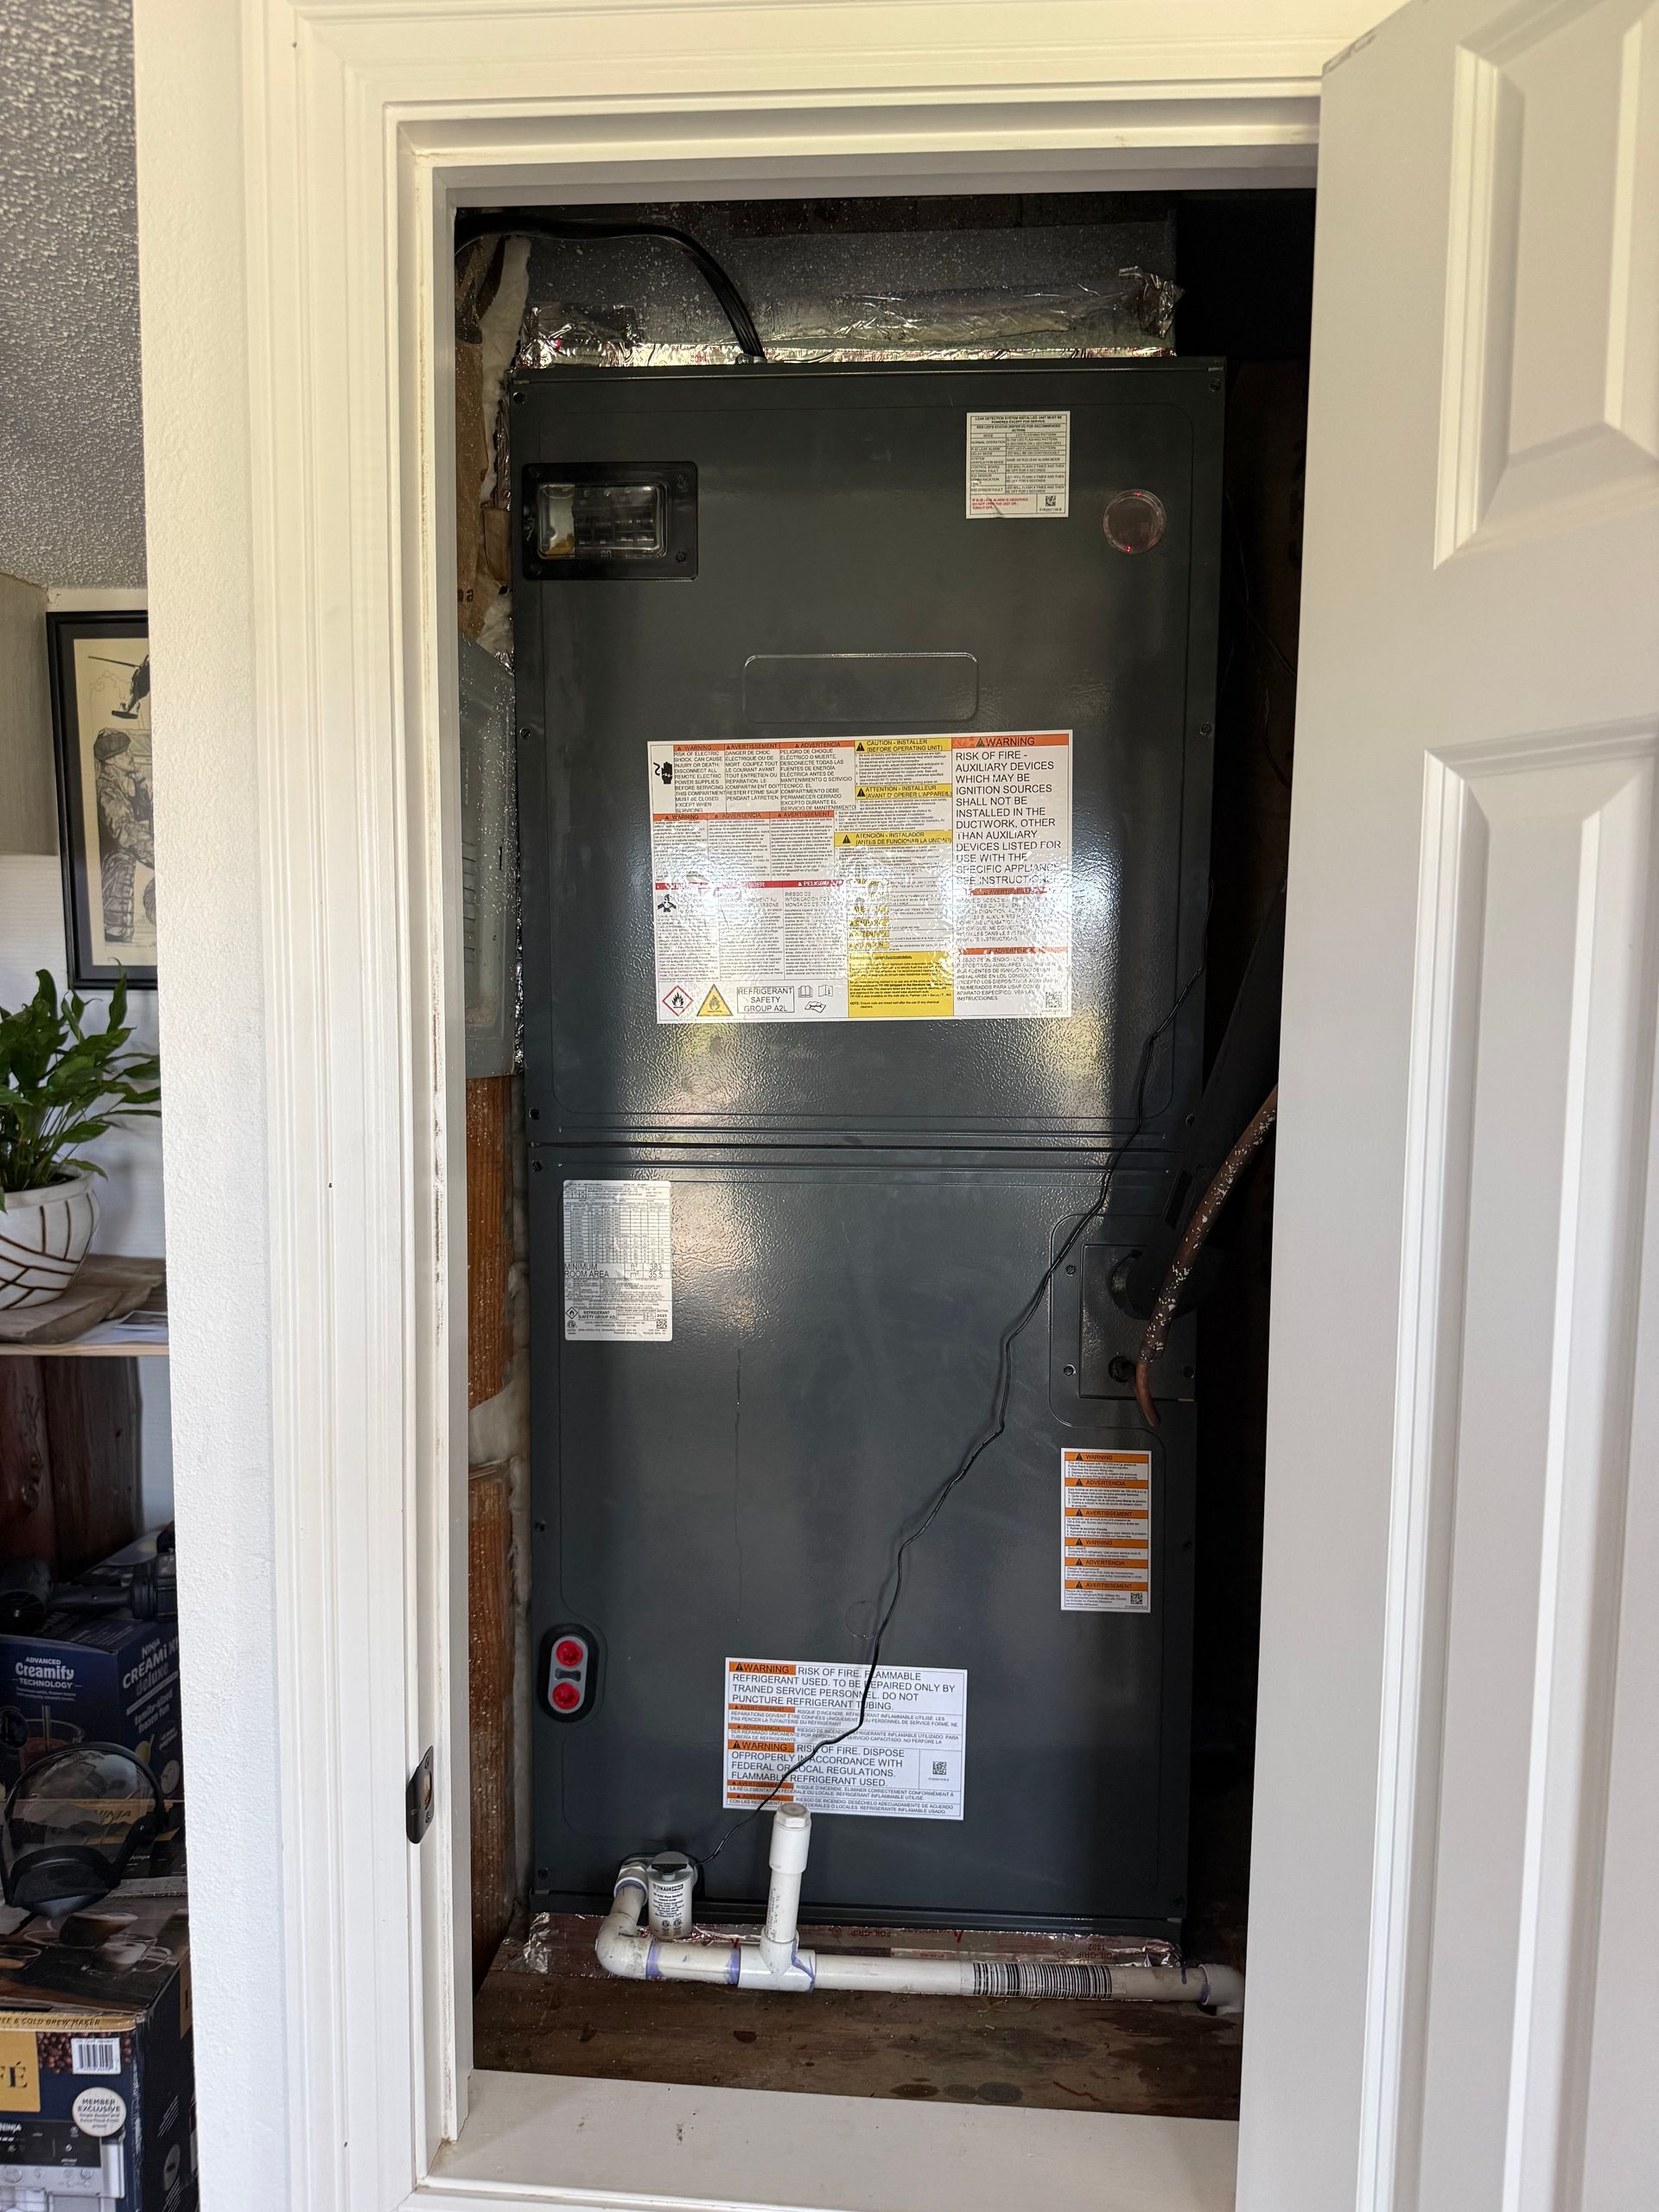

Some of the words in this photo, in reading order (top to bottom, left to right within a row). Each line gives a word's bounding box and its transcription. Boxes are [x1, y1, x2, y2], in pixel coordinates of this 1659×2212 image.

[985, 737, 1035, 747] WARNING
[956, 763, 1007, 772] AUXILIARY
[1010, 761, 1053, 770] DEVICES
[957, 786, 1000, 795] IGNITION
[1003, 785, 1052, 793] SOURCES
[956, 798, 987, 806] SHALL
[991, 797, 1011, 805] NOT
[957, 809, 1010, 817] INSTALLED
[957, 820, 1018, 829] DUCTWORK,
[1020, 818, 1055, 827] OTHER
[986, 830, 1037, 839] AUXILIARY
[957, 842, 1000, 851] DEVICES
[1002, 842, 1037, 850] LISTED
[980, 854, 1005, 862] WITH
[1008, 853, 1027, 861] THE
[957, 865, 1001, 874] SPECIFIC
[16, 1662, 74, 1680] Creamify
[744, 1663, 789, 1674] WARNING
[798, 1667, 820, 1675] RISK
[838, 1669, 861, 1678] FIRE.
[19, 1678, 73, 1688] TECHNOLOGY
[733, 1674, 799, 1684] REFRIGERANT
[914, 1683, 940, 1692] ONLY
[733, 1684, 773, 1694] TRAINED
[776, 1687, 817, 1695] SERVICE
[733, 1694, 783, 1704] PUNCTURE
[787, 1698, 854, 1707] REFRIGERANT
[742, 1742, 787, 1751] WARNING
[863, 1748, 905, 1757] DISPOSE
[732, 1762, 774, 1770] FEDERAL
[795, 1764, 823, 1773] OCAL
[827, 1766, 895, 1777] REGULATIONS.
[791, 1775, 856, 1785] REFRIGERANT
